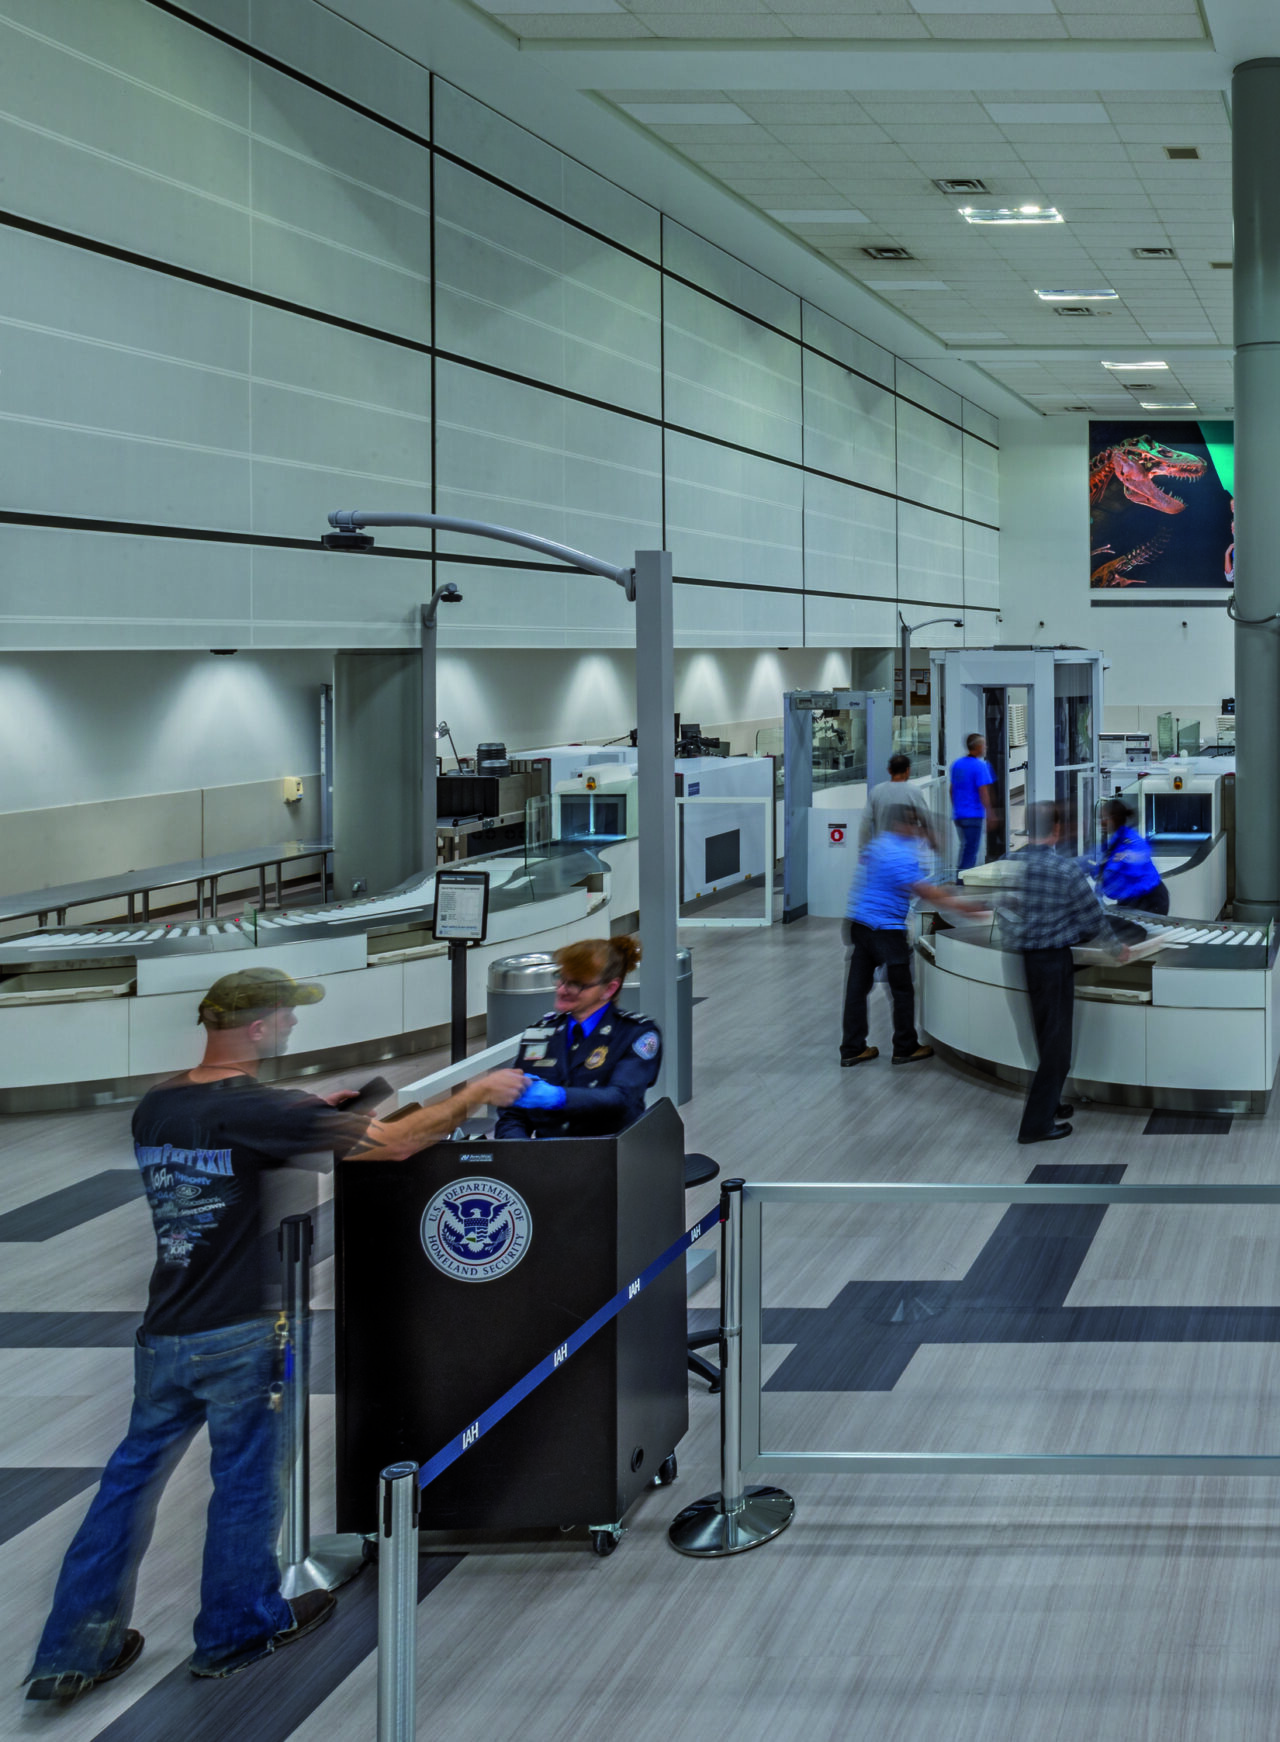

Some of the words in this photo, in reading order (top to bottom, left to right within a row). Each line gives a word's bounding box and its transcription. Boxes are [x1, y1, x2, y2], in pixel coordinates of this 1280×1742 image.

[445, 1183, 517, 1208] DEPARTMENT
[514, 1208, 524, 1222] OF
[691, 1224, 701, 1242] IAH
[428, 1234, 478, 1276] HOMELAND
[482, 1233, 525, 1275] SECURITY
[628, 1278, 641, 1300] IAH
[553, 1343, 568, 1367] IAH
[462, 1422, 479, 1450] IAH
